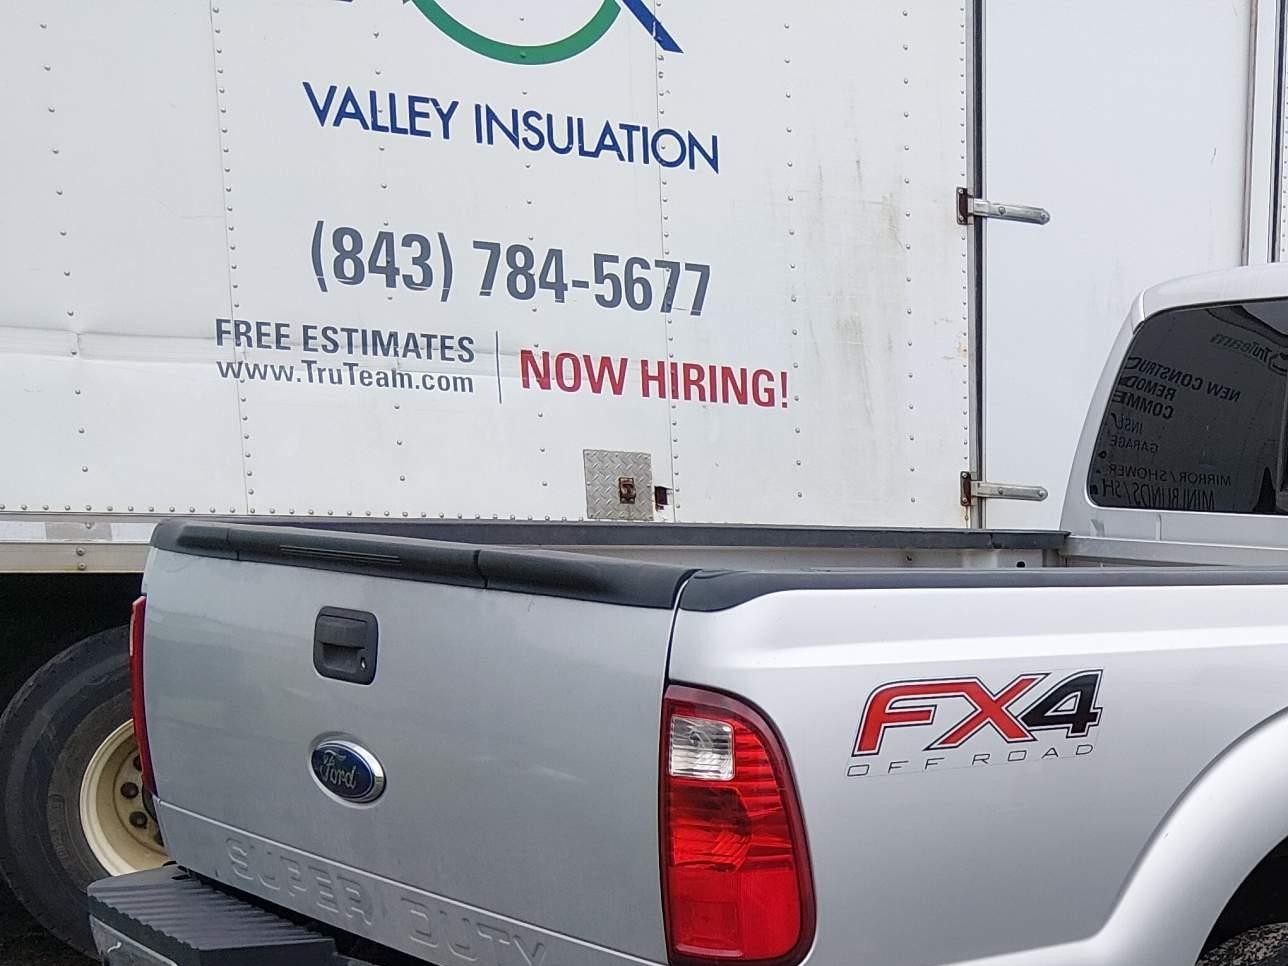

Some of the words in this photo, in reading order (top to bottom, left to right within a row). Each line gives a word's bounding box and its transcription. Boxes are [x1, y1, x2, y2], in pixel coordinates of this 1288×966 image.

[302, 81, 460, 140] VALLEY
[474, 102, 720, 175] INSULATION
[310, 219, 454, 303] (843)
[472, 239, 711, 317] 784-5677
[215, 318, 292, 351] FREE
[301, 324, 475, 363] ESTIMATES
[215, 359, 475, 393] www.TruTeam.com
[520, 348, 629, 396] NOW
[640, 358, 789, 409] HIRING!
[850, 668, 1104, 758] FX4
[319, 749, 358, 790] Ford
[846, 756, 946, 778] OFF
[971, 743, 1094, 766] ROAD
[225, 834, 374, 928] SUPER
